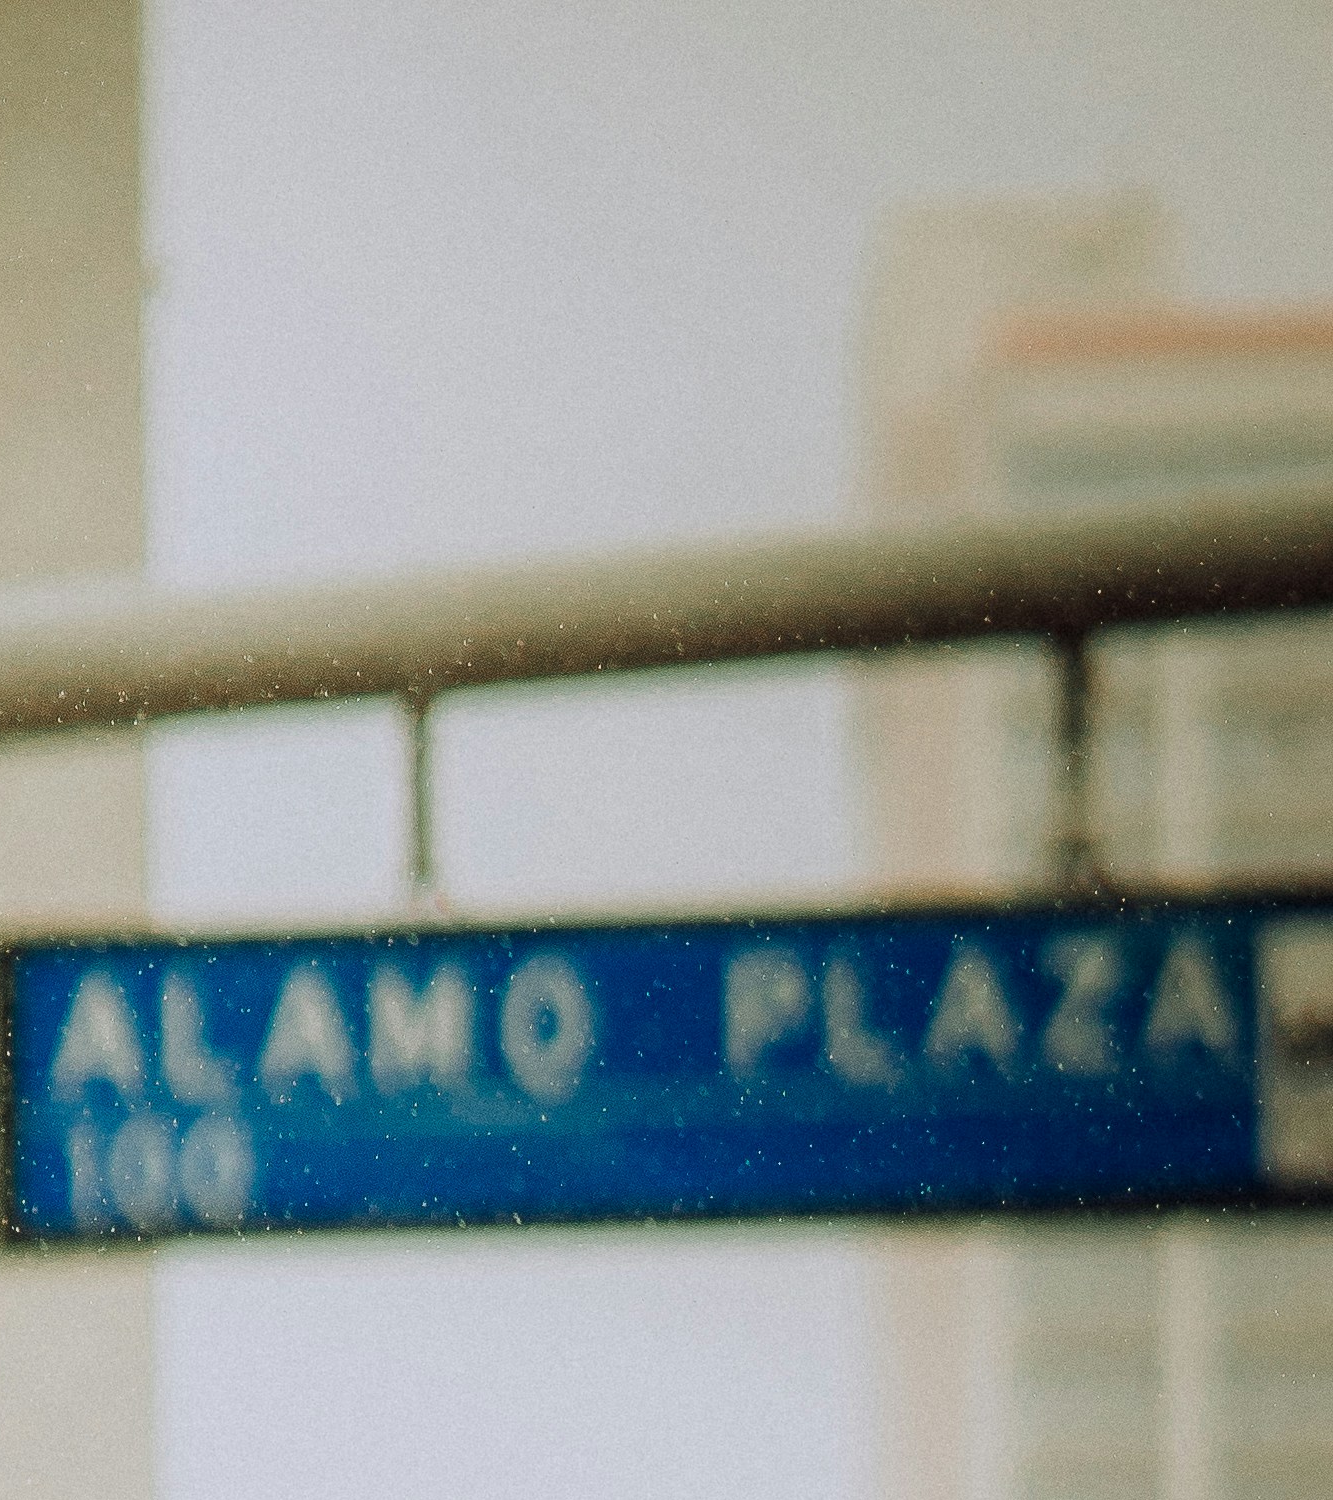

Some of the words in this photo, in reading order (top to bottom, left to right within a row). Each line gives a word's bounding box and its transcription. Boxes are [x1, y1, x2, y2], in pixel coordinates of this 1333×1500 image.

[51, 953, 595, 1106] ALAMO
[721, 936, 1237, 1090] PLAZA
[65, 1112, 255, 1228] 100
